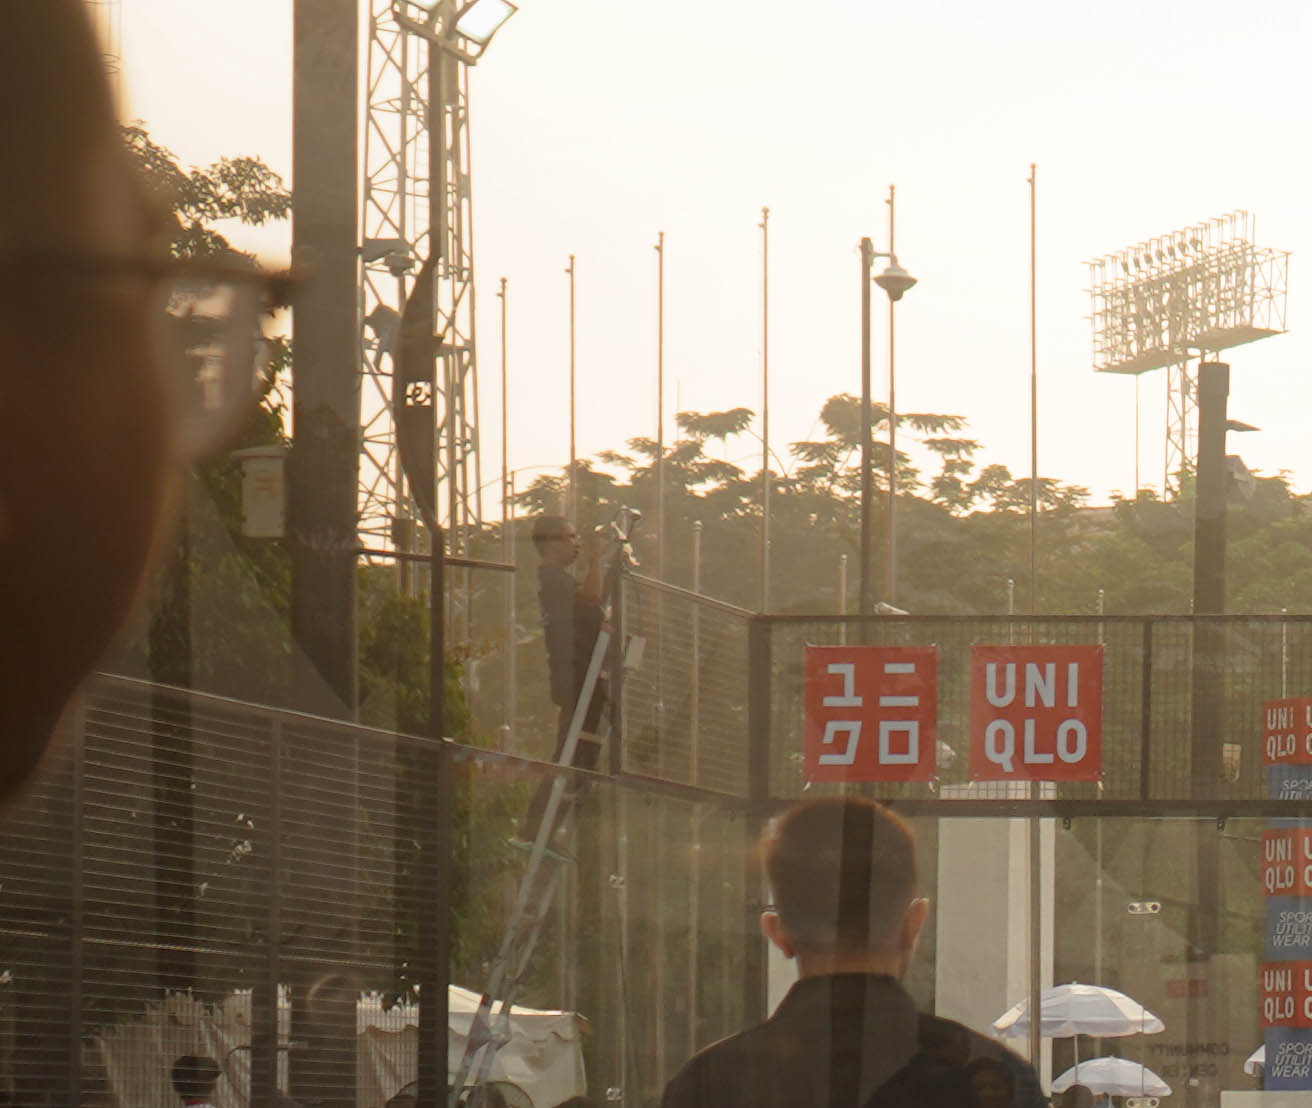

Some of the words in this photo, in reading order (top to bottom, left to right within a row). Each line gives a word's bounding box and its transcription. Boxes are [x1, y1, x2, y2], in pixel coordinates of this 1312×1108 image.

[985, 662, 1079, 708] UNI
[1267, 707, 1294, 730] UNI
[984, 718, 1088, 773] QLO
[1266, 733, 1296, 760] QLO
[1265, 837, 1292, 862] UNI
[1264, 866, 1295, 893] QLO
[1272, 934, 1311, 947] WEAR
[1264, 969, 1292, 993] UNI
[1264, 996, 1295, 1023] QLO
[1271, 1065, 1310, 1078] WEAR
